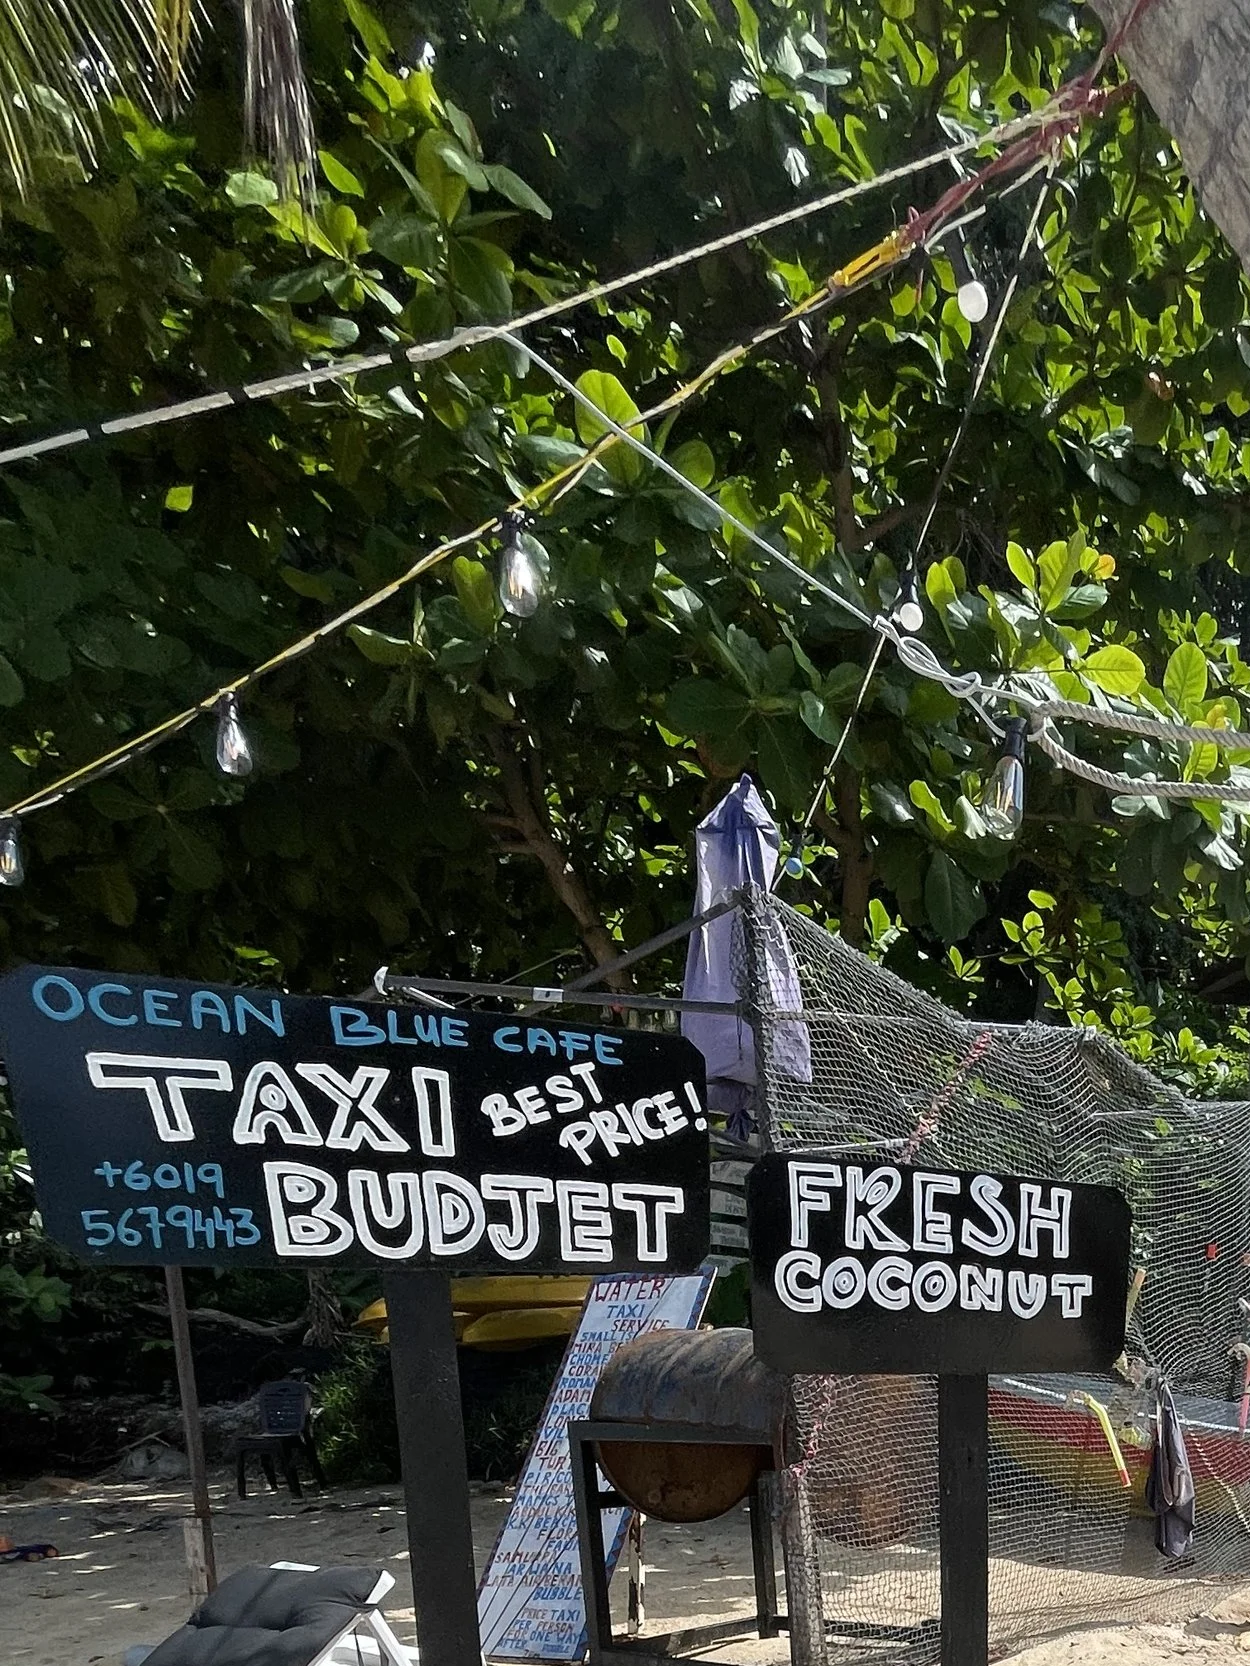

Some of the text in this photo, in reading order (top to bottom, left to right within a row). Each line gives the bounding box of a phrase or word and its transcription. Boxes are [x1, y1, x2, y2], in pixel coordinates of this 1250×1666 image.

[32, 975, 624, 1066] OCEAN BLUE CAFE
[85, 1051, 455, 1158] TAXI
[480, 1062, 603, 1137] BEST
[559, 1081, 708, 1166] PRICE!
[94, 1160, 225, 1199] +6019
[81, 1205, 261, 1249] 5679443
[263, 1161, 684, 1263] BUDJET
[787, 1160, 1072, 1259] FRESH
[595, 1278, 666, 1302] WATER
[607, 1304, 645, 1318] TAXI
[774, 1250, 1093, 1320] COCONUT
[580, 1331, 617, 1342] SMALL
[529, 1630, 552, 1643] ONE
[550, 1608, 580, 1621] TAXI
